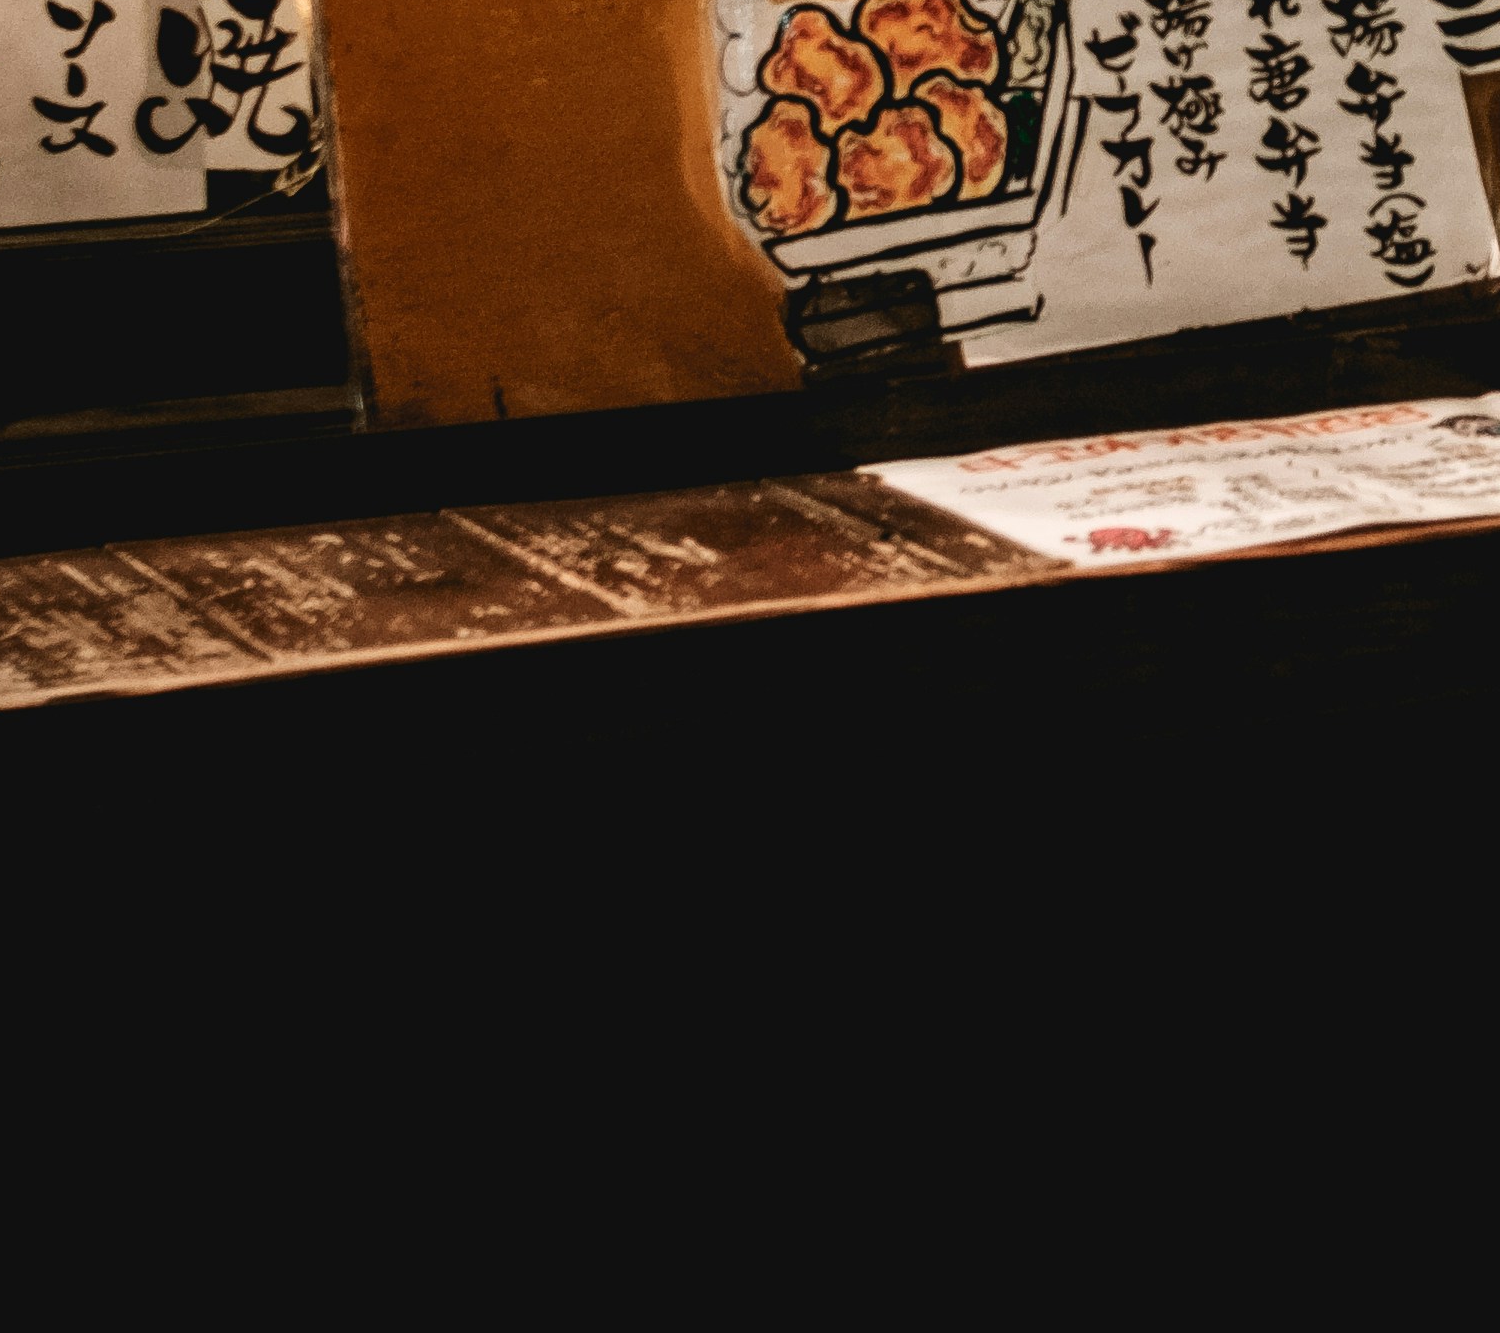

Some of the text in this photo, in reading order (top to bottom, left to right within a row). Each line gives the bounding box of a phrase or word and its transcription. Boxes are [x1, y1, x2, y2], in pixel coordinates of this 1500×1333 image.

[1084, 14, 1160, 286] ビーフカレー
